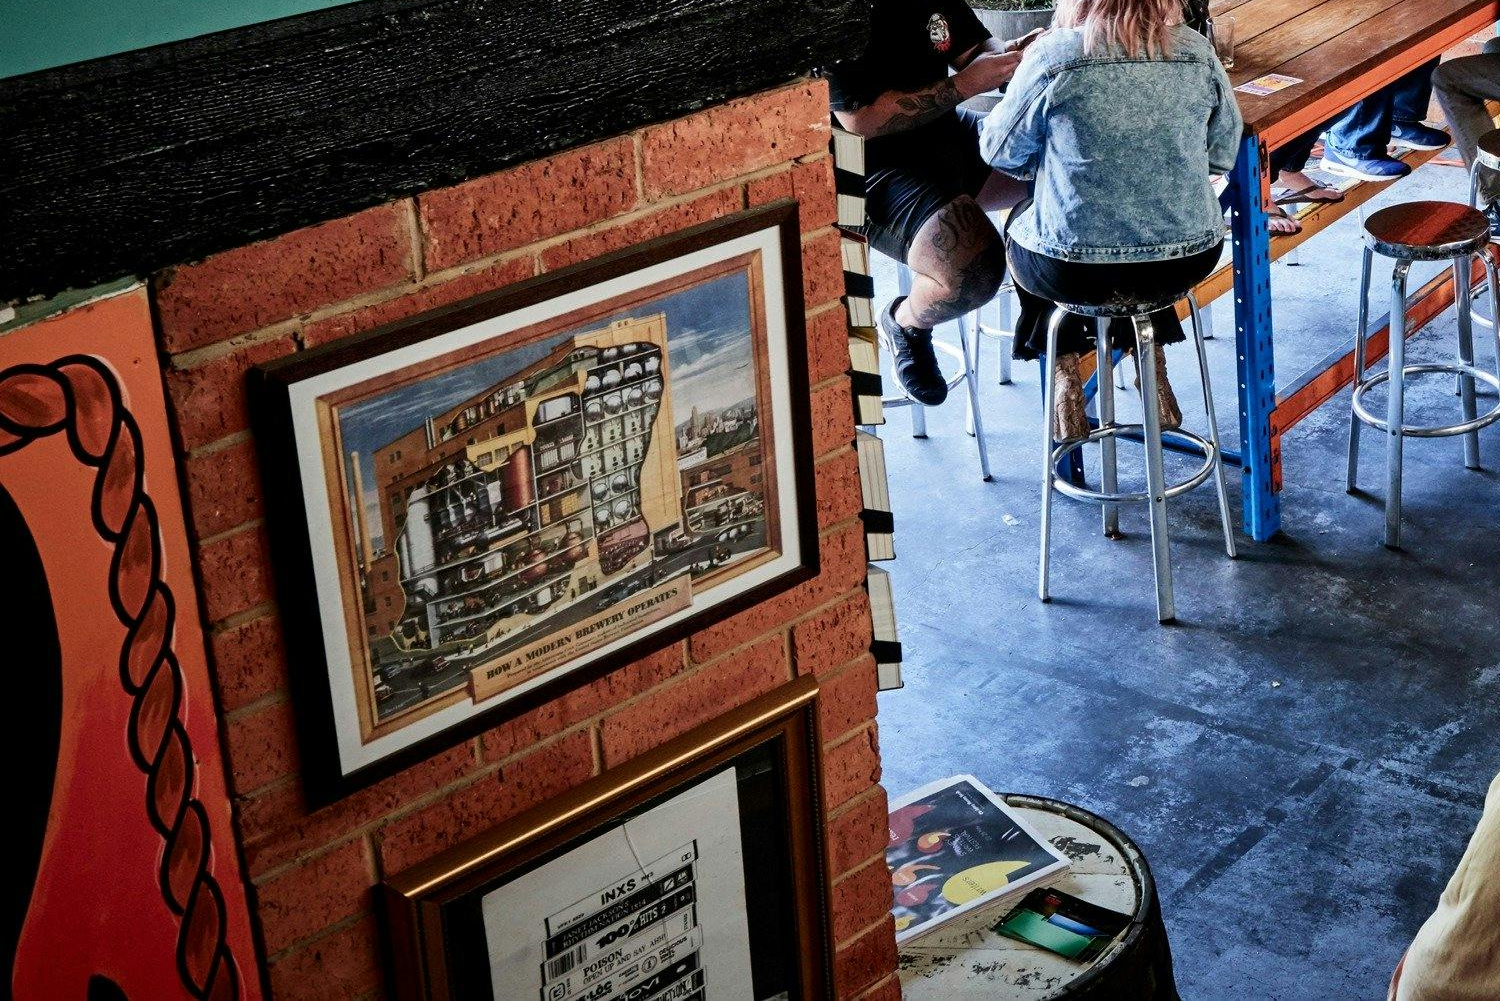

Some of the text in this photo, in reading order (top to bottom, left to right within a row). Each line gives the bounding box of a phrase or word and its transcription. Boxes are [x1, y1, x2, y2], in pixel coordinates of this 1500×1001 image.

[486, 661, 512, 680] HOW
[513, 657, 523, 668] A
[525, 635, 572, 660] MODERN
[575, 610, 625, 639] BREWERY
[627, 588, 678, 617] OPERATES
[601, 878, 637, 906] INXS
[640, 908, 659, 925] HITS
[661, 905, 667, 915] 2
[659, 936, 687, 955] DELICIOUS
[583, 948, 623, 977] POISON
[583, 967, 604, 985] OPEN
[605, 962, 615, 973] UP
[617, 953, 631, 965] AND
[633, 944, 646, 956] SAY
